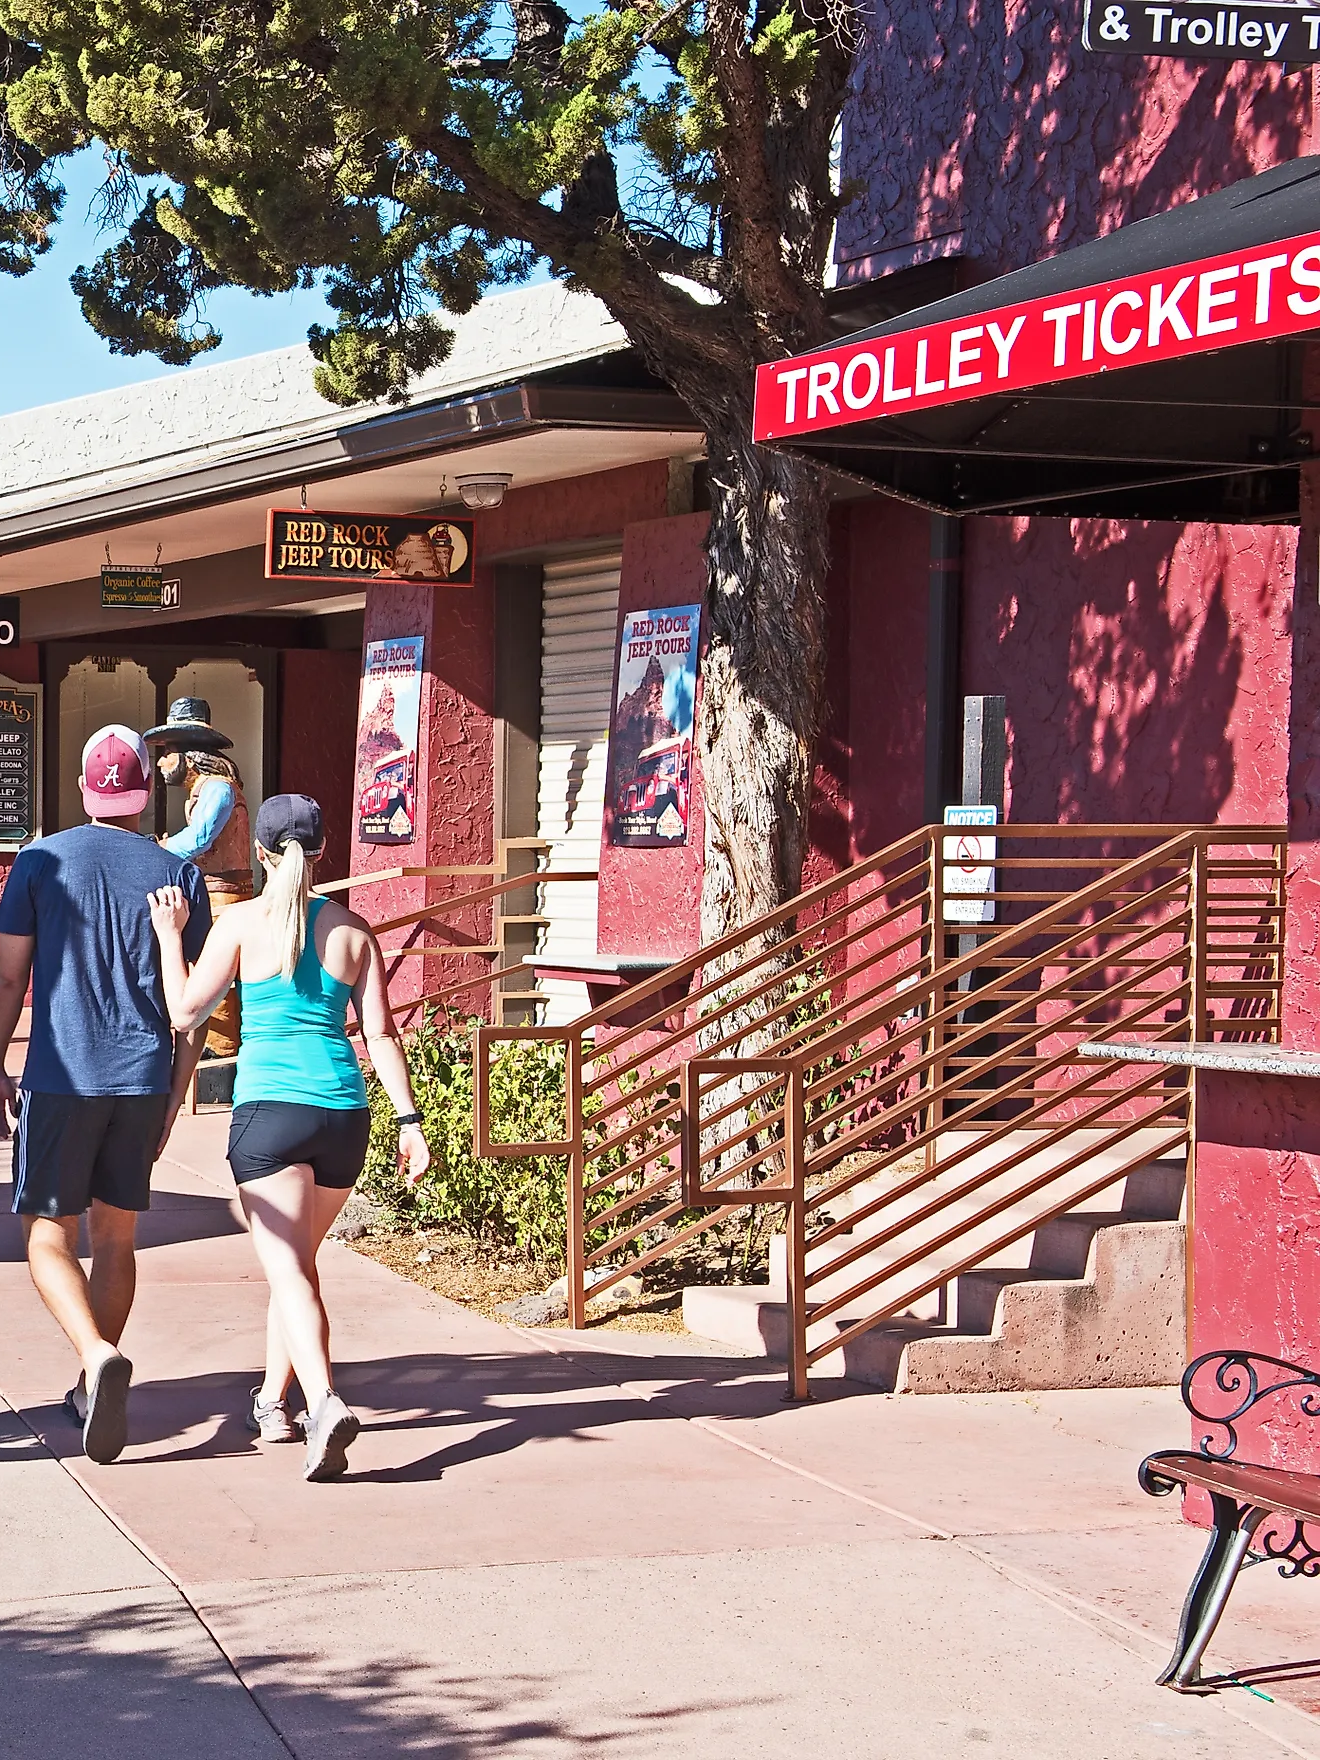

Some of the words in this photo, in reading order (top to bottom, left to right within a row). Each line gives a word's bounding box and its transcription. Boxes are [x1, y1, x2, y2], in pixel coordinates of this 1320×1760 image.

[1099, 5, 1130, 42] &
[1145, 8, 1289, 57] Trolley
[776, 316, 1026, 424] TROLLEY
[1042, 245, 1320, 368] TICKETS
[285, 521, 326, 543] RED
[332, 523, 390, 547] ROCK
[278, 544, 324, 570] JEEP
[328, 546, 396, 570] TOURS
[104, 575, 135, 590] Organic
[137, 576, 160, 587] Coffee
[103, 590, 127, 604] Espresso
[161, 583, 178, 605] 01
[632, 619, 654, 637] RED
[656, 615, 690, 634] ROCK
[373, 649, 388, 663] RED
[390, 645, 416, 661] ROCK
[627, 641, 653, 663] JEEP
[655, 636, 692, 656] TOURS
[369, 667, 387, 684] JEEP
[388, 663, 417, 678] TOURS
[0, 734, 20, 742] JEEP
[97, 763, 122, 788] A
[949, 811, 993, 825] NOTICE
